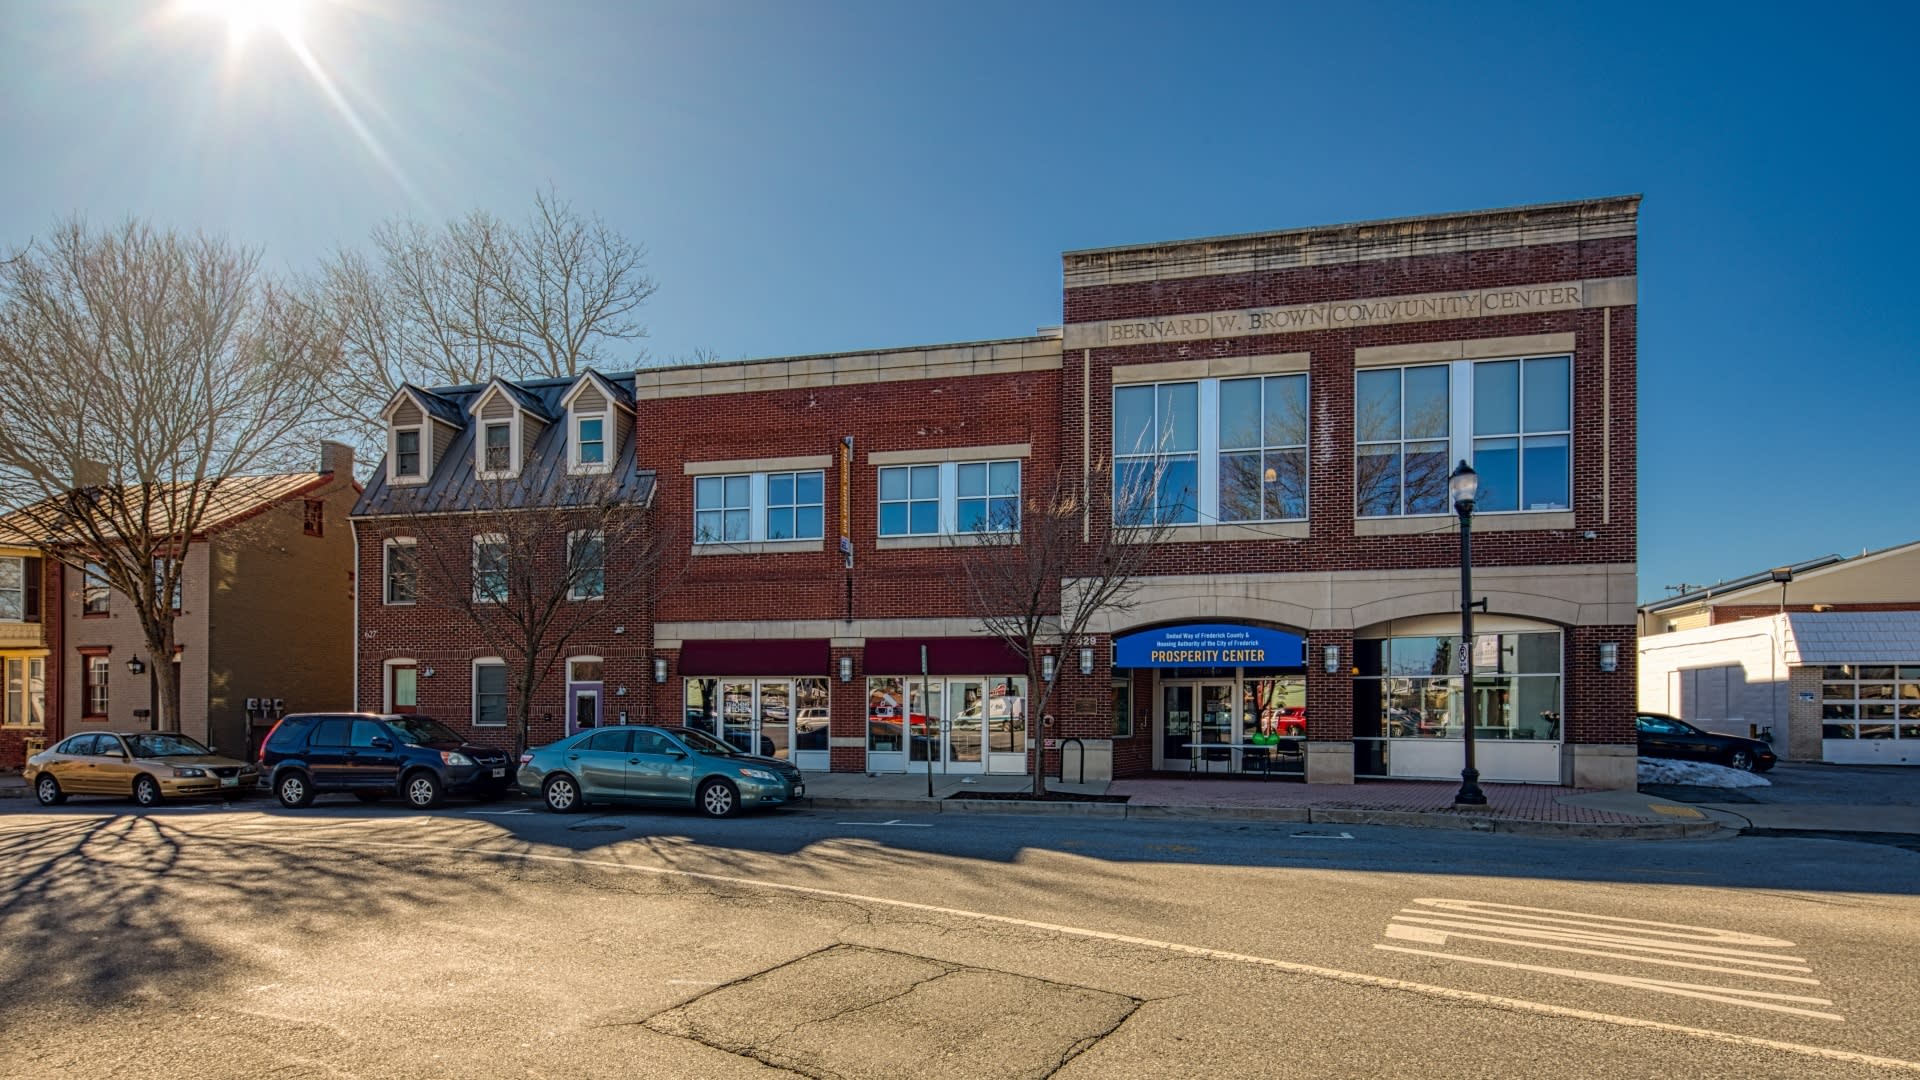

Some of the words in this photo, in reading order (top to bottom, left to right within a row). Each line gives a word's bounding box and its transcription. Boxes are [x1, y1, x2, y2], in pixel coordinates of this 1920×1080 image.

[1110, 318, 1210, 341] BERNARD
[1216, 315, 1242, 332] W.
[1248, 307, 1327, 331] BROWN
[1333, 294, 1480, 322] COMMUNITY
[1484, 287, 1581, 310] CENTER
[1217, 640, 1227, 648] City
[1152, 650, 1219, 663] PROSPERITY
[1223, 650, 1265, 662] CENTER
